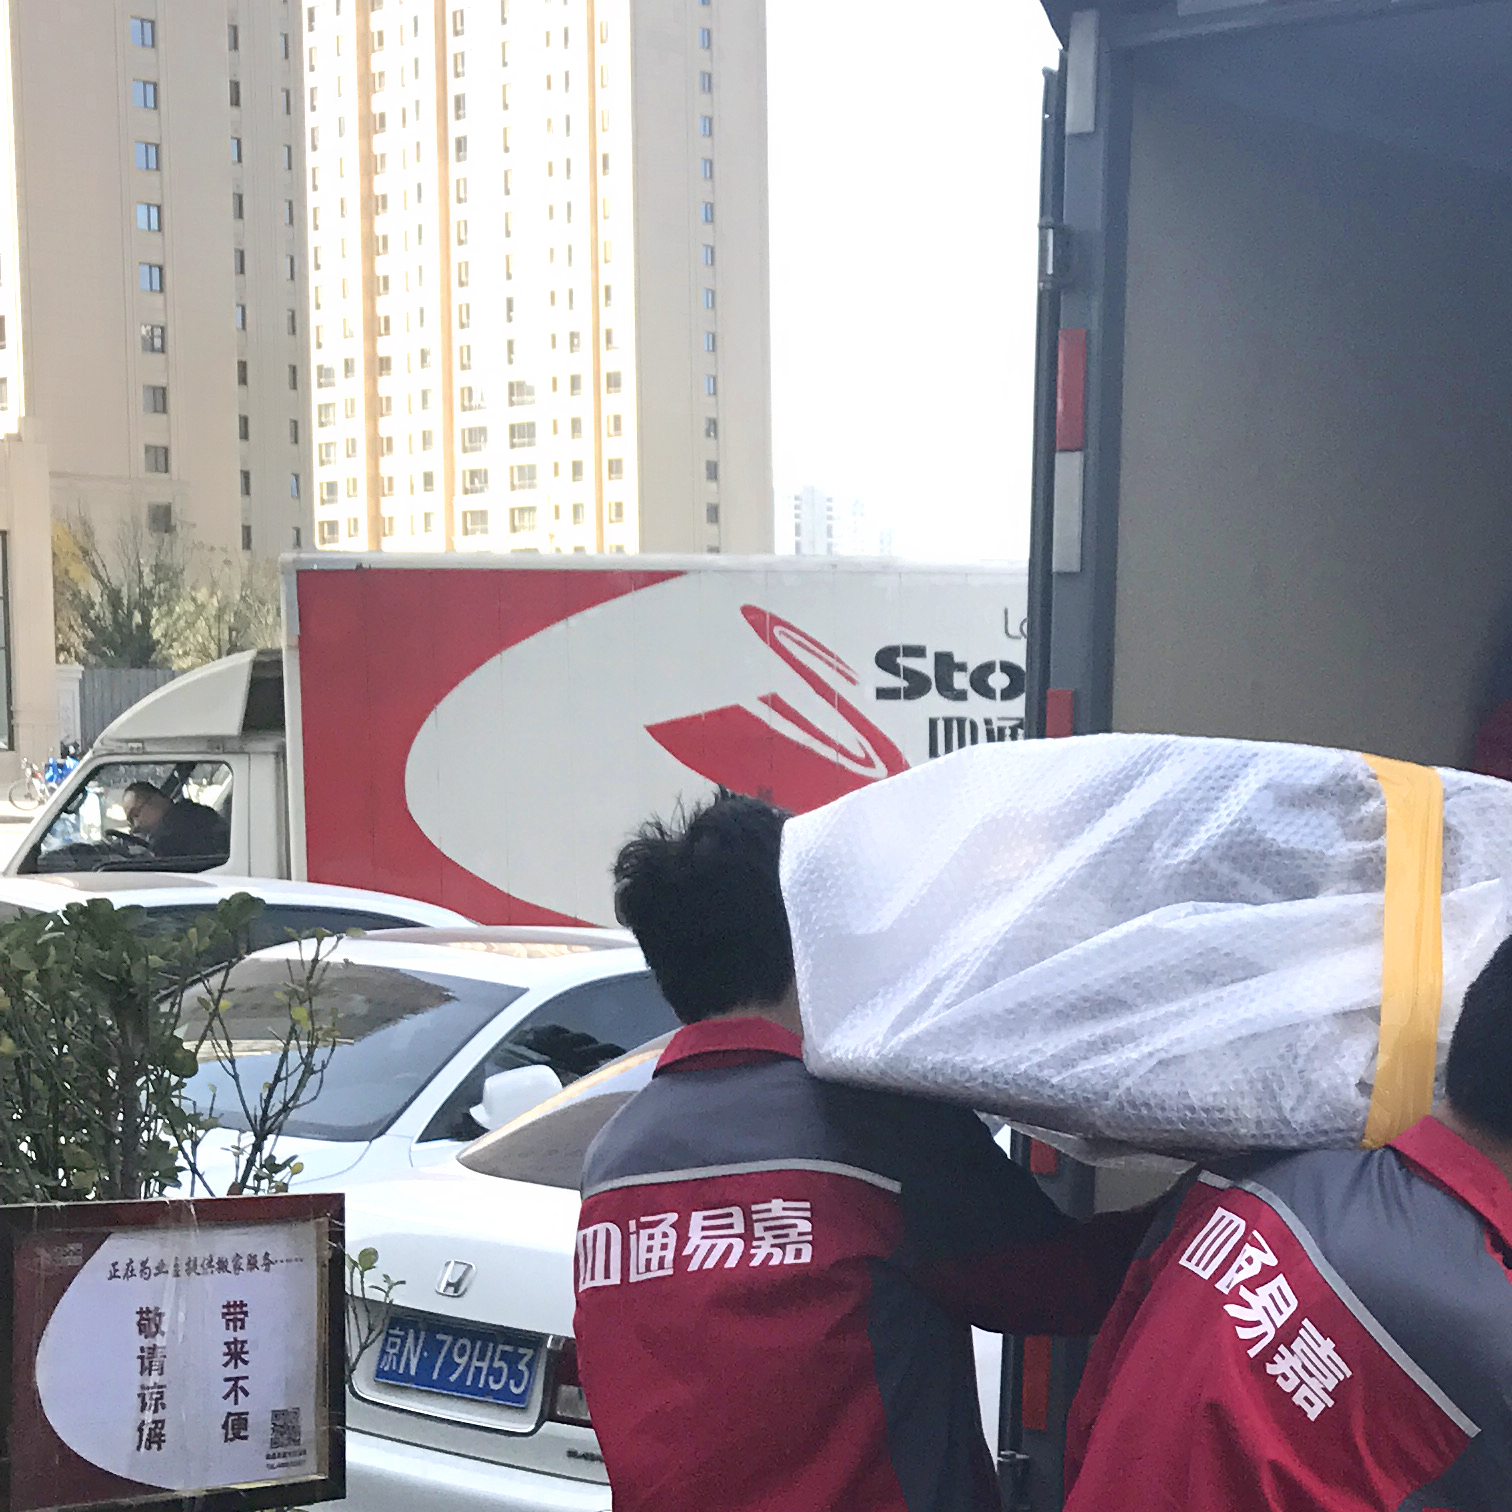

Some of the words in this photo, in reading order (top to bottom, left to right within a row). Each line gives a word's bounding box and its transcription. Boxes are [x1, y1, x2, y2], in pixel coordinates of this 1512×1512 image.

[576, 1198, 813, 1294] 四通易嘉
[136, 1306, 167, 1452] 敬请谅解
[221, 1300, 250, 1443] 带来不便
